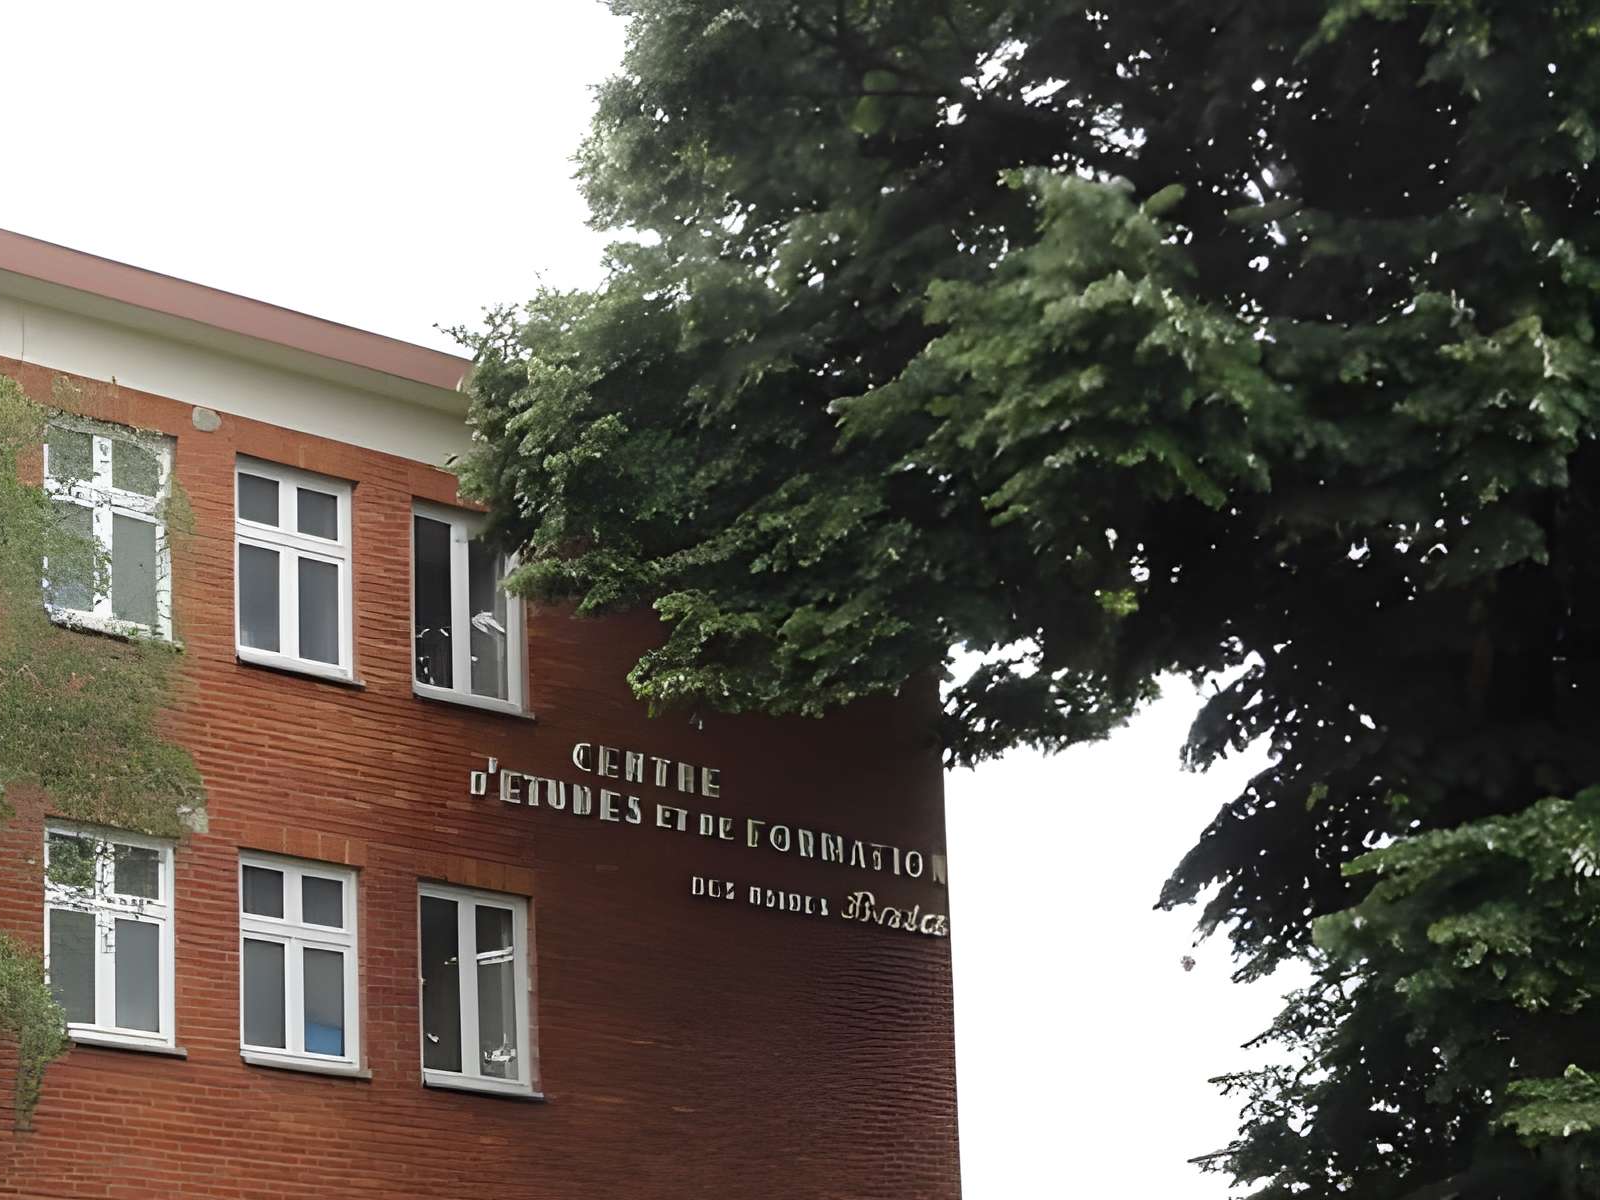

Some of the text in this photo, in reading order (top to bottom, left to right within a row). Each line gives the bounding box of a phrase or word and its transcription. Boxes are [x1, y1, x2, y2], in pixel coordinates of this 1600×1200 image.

[572, 742, 721, 798] CENTRE
[656, 804, 688, 832] ET
[699, 813, 735, 841] DE
